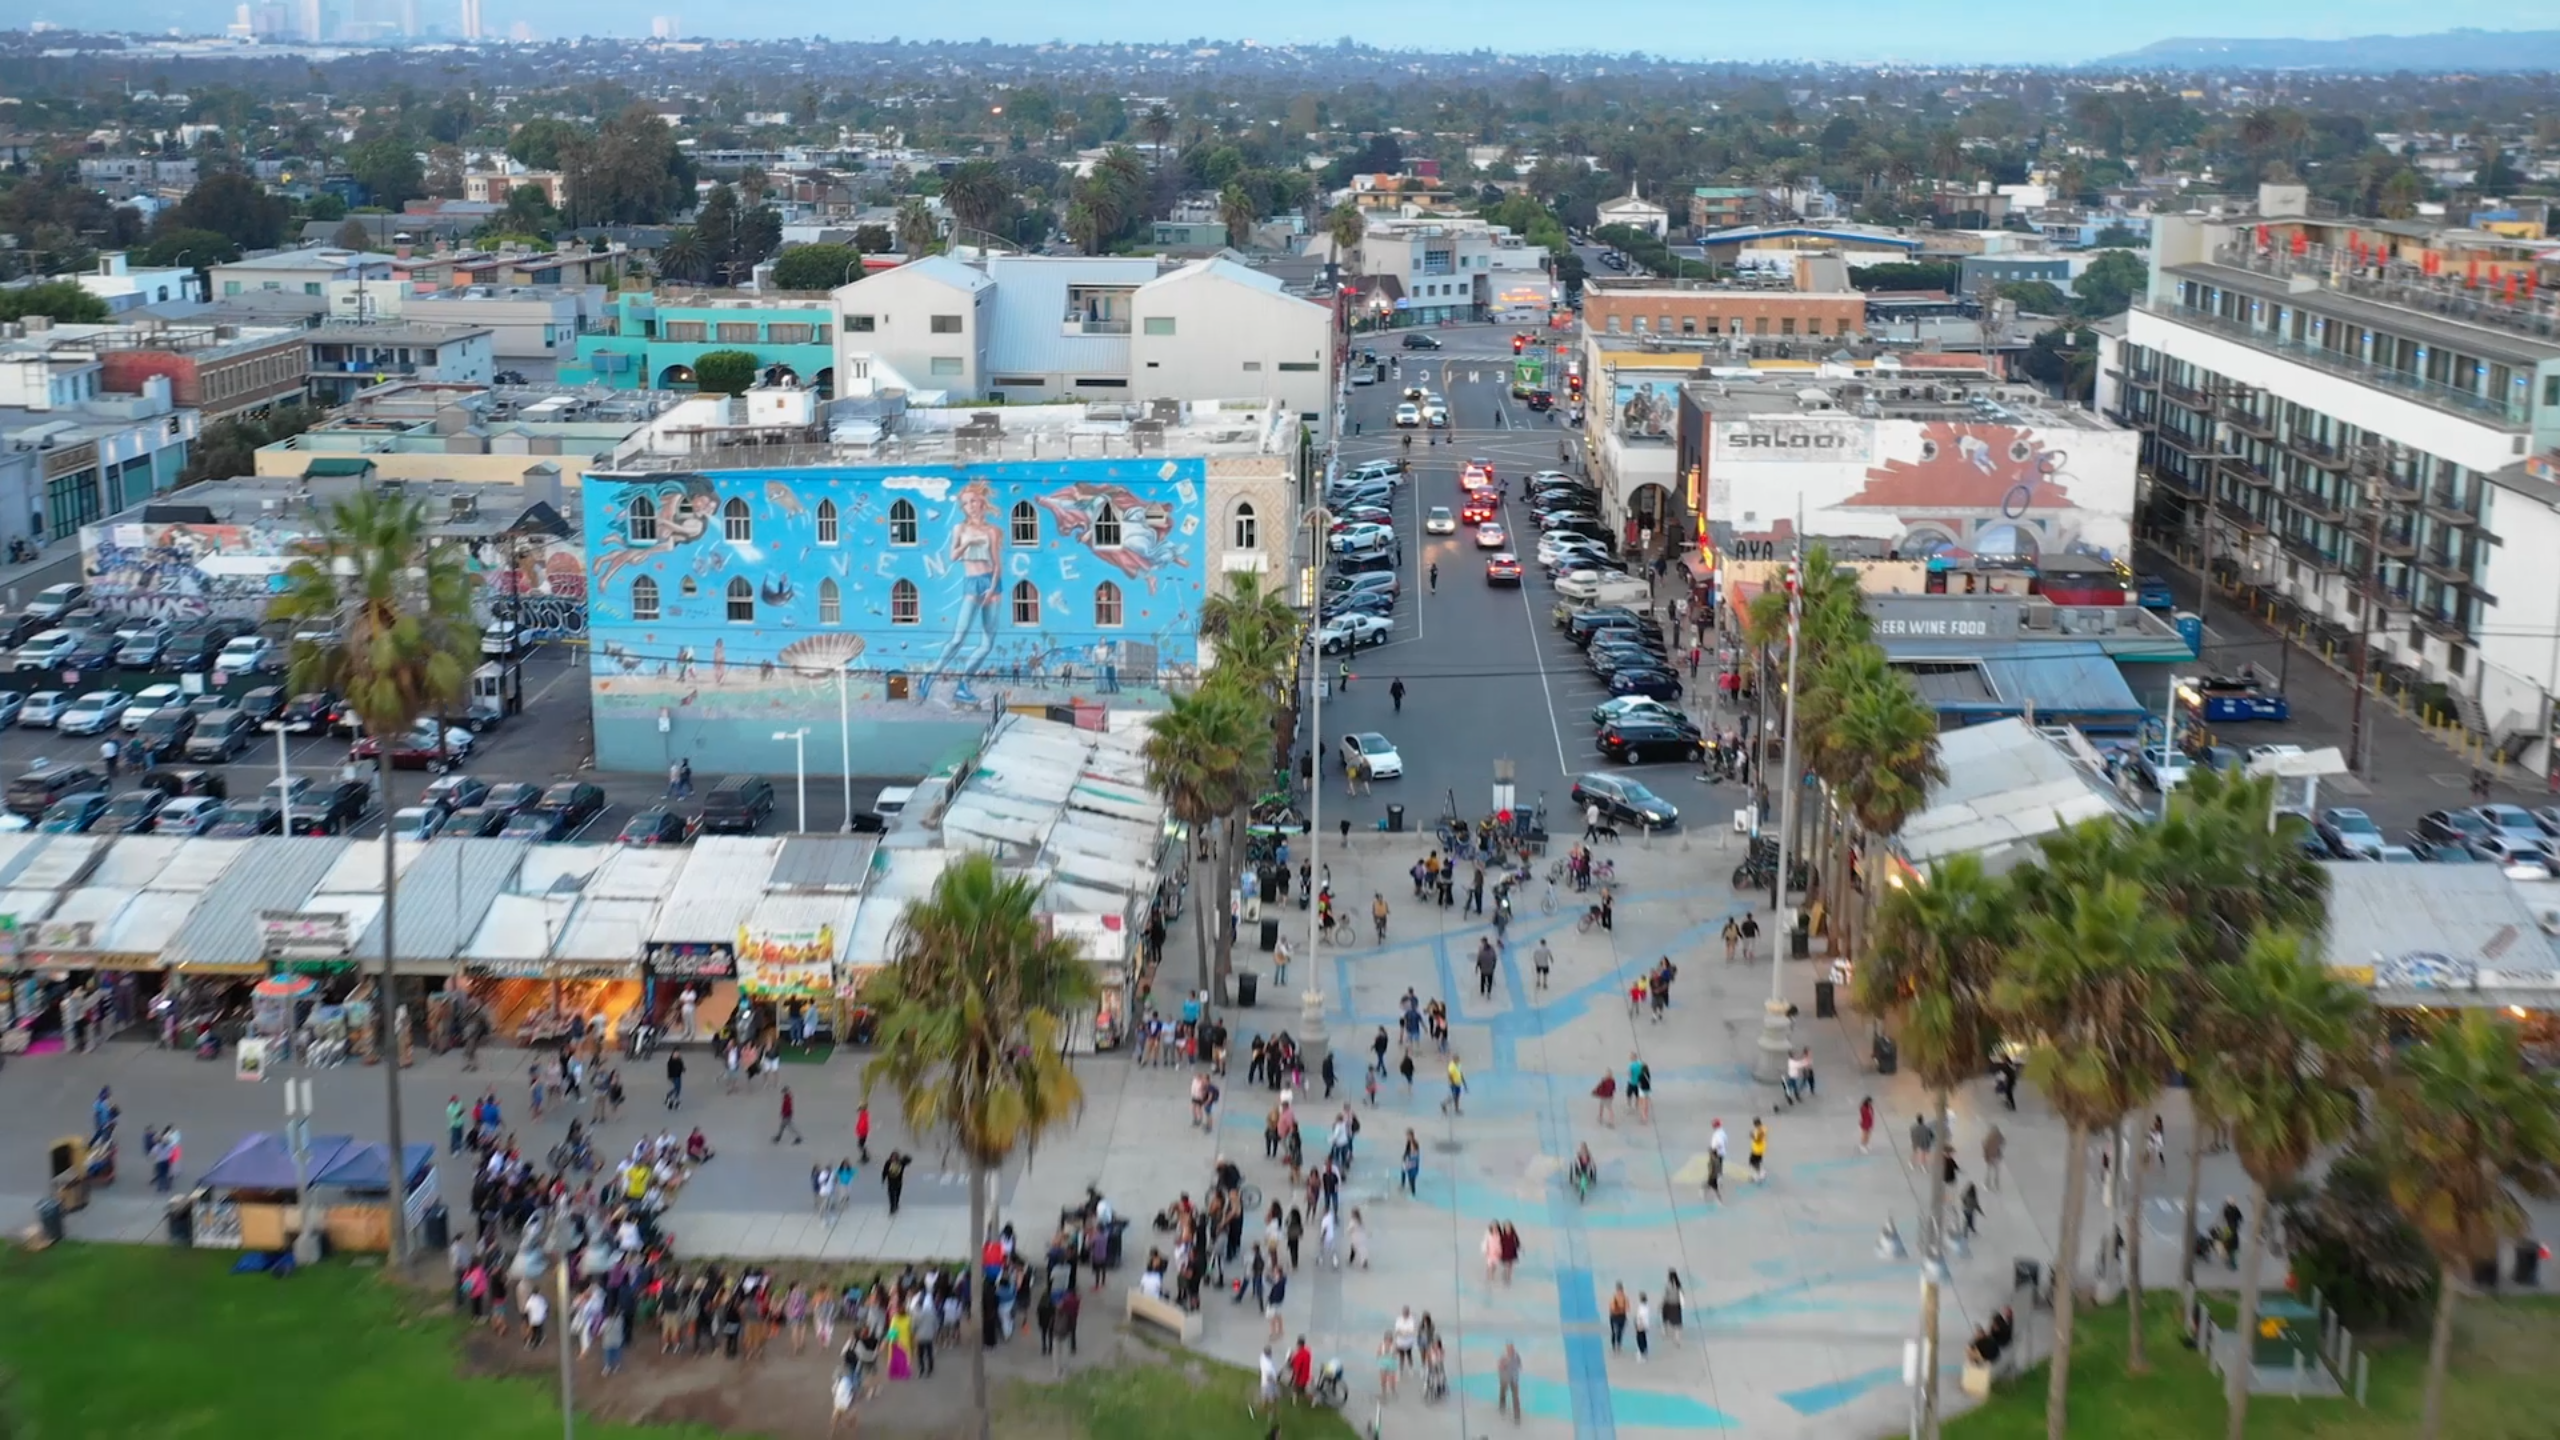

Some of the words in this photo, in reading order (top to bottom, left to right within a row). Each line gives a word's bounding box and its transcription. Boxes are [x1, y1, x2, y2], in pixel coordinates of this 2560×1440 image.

[1735, 540, 1773, 561] AYA
[831, 551, 1081, 581] VENCE
[1908, 619, 1947, 635] WINE
[1950, 620, 1986, 636] FOOD
